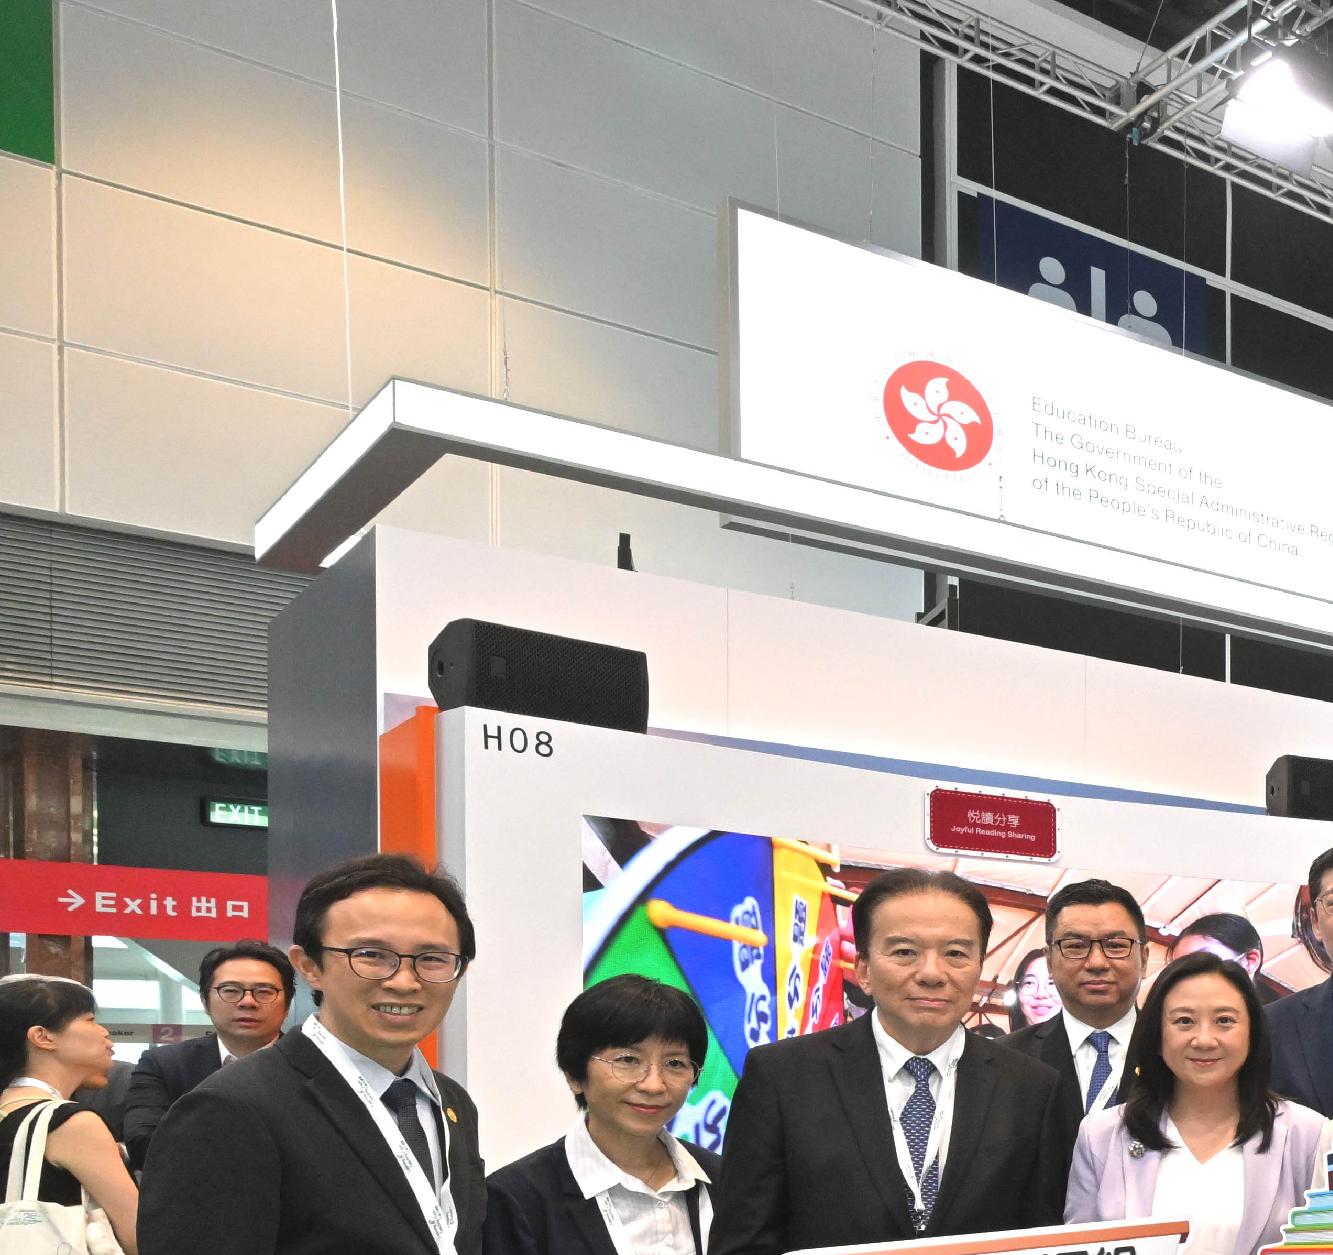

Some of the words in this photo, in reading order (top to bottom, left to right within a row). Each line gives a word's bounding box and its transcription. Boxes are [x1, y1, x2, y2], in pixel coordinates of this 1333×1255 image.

[1032, 396, 1119, 434] Education
[1032, 421, 1064, 445] The
[1070, 433, 1172, 476] Government
[1178, 466, 1193, 480] of
[1199, 470, 1223, 489] the
[1033, 448, 1079, 478] Hong
[1085, 463, 1128, 491] Kong
[1135, 476, 1194, 505] Special
[1200, 495, 1305, 535] Administrative
[1032, 477, 1049, 492] of
[1056, 481, 1082, 501] the
[1089, 489, 1160, 522] People's
[1165, 508, 1233, 541] Republic
[1238, 532, 1251, 545] of
[1257, 533, 1298, 557] China
[483, 723, 554, 758] H08
[214, 803, 262, 826] EXIT
[951, 826, 974, 835] Joyful
[975, 827, 1006, 839] Reading
[1007, 831, 1037, 841] Sharing
[95, 891, 178, 917] Exit
[191, 896, 249, 918] 出口
[160, 1026, 175, 1041] 2
